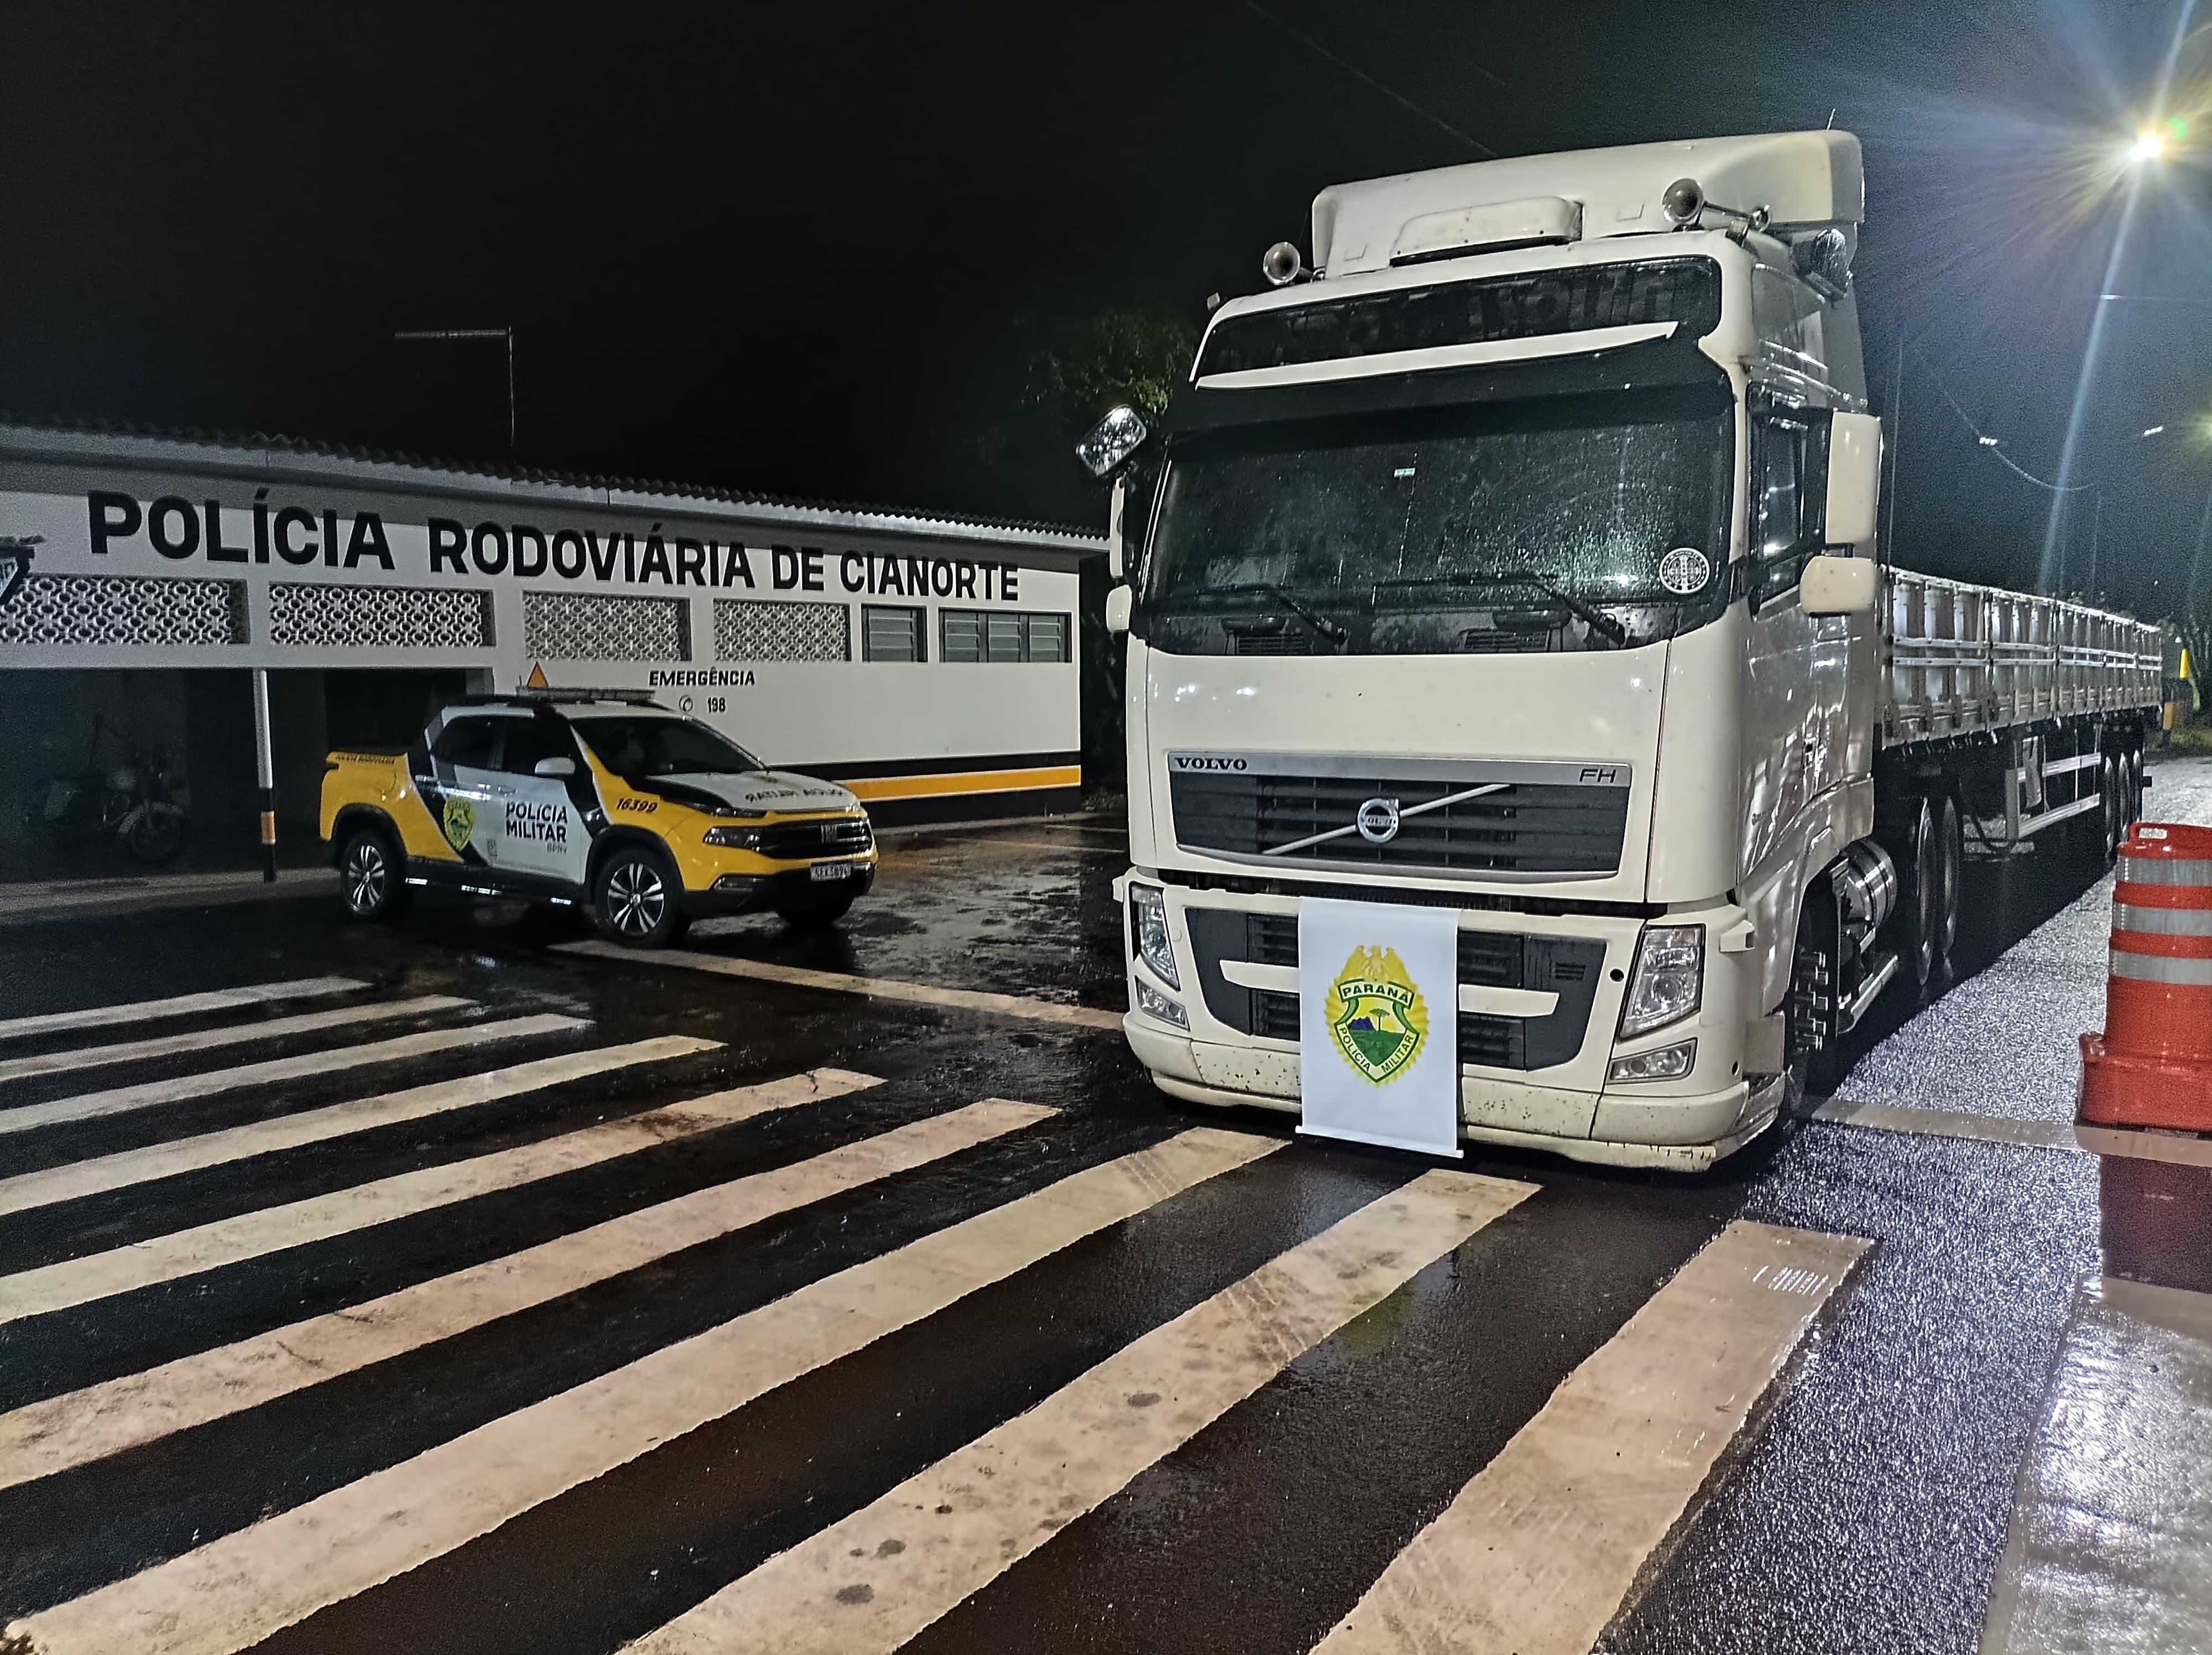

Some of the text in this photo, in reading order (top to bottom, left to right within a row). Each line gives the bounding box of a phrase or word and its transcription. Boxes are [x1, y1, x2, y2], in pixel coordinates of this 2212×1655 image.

[87, 488, 1019, 601] POLÍCIA RODOVIÁRIA DE CIANORTE
[649, 666, 755, 686] EMERGÊNCIA
[708, 697, 726, 713] 198
[1175, 757, 1247, 770] VOLVO
[1579, 768, 1616, 783] FH
[616, 798, 658, 813] 16399
[506, 820, 566, 842] MILITAR
[1342, 984, 1408, 1004] PARANÁ
[1381, 1034, 1414, 1073] MILITAR
